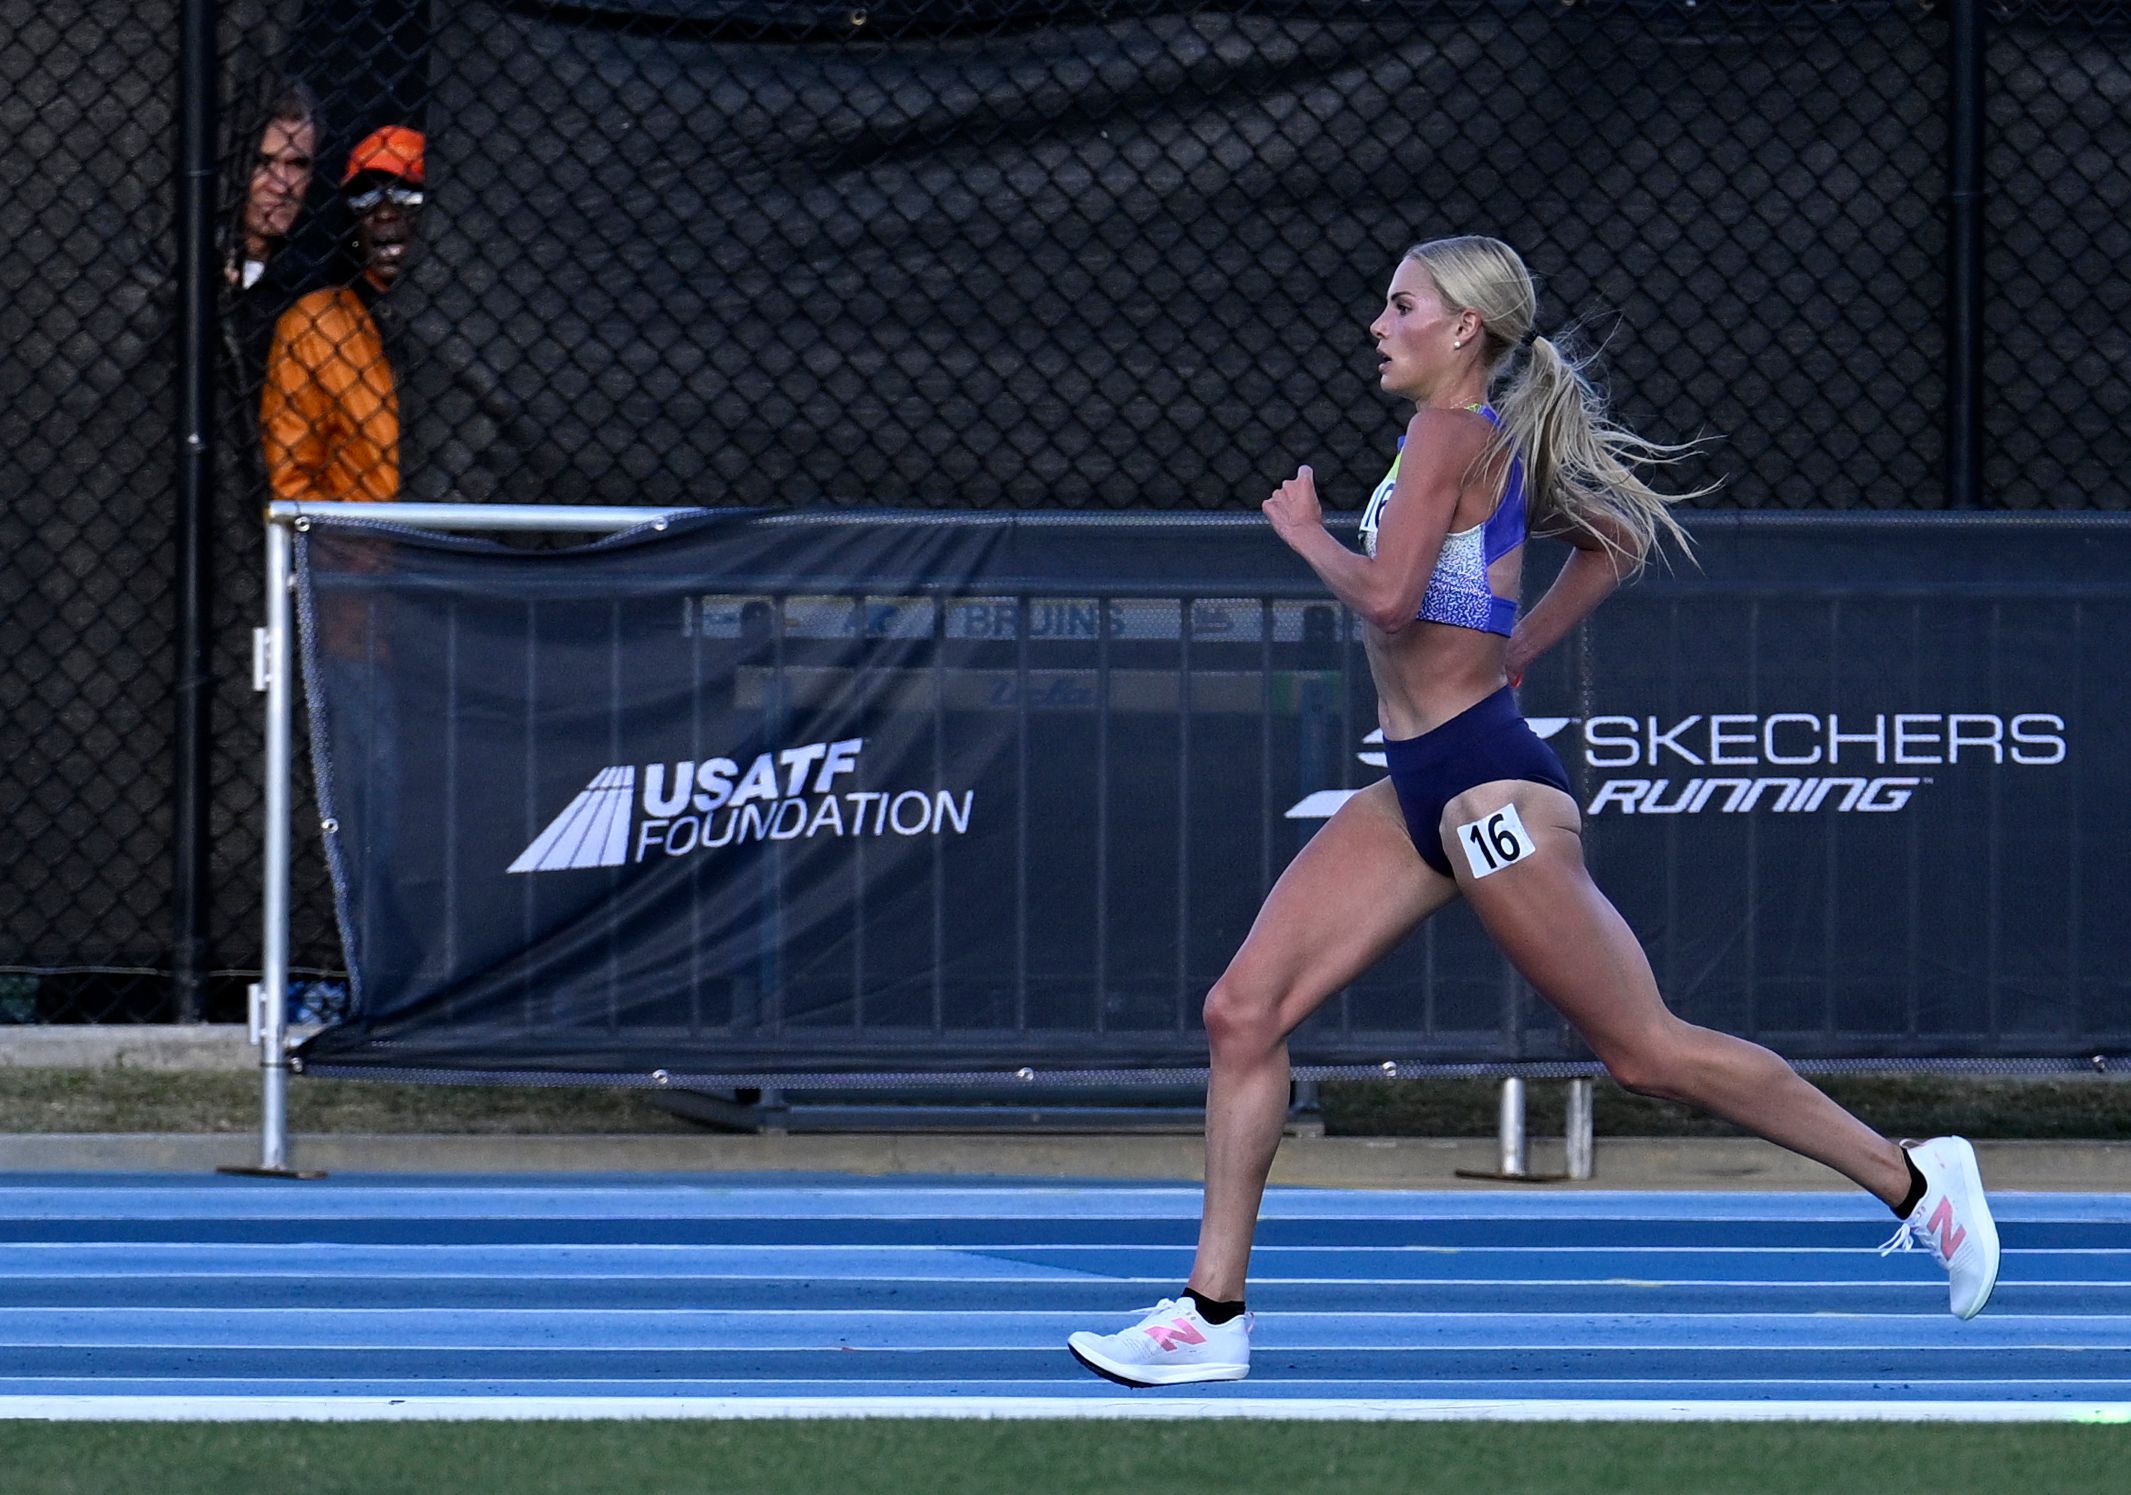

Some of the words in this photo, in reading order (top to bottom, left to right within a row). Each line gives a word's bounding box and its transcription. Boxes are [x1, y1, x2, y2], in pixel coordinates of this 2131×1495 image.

[964, 605, 1127, 637] BRUINS
[1584, 713, 2067, 768] SKECHERS
[642, 737, 864, 818] USATF
[1586, 776, 1921, 815] RUNNING
[635, 789, 974, 863] FOUNDATION
[1469, 812, 1521, 870] 16
